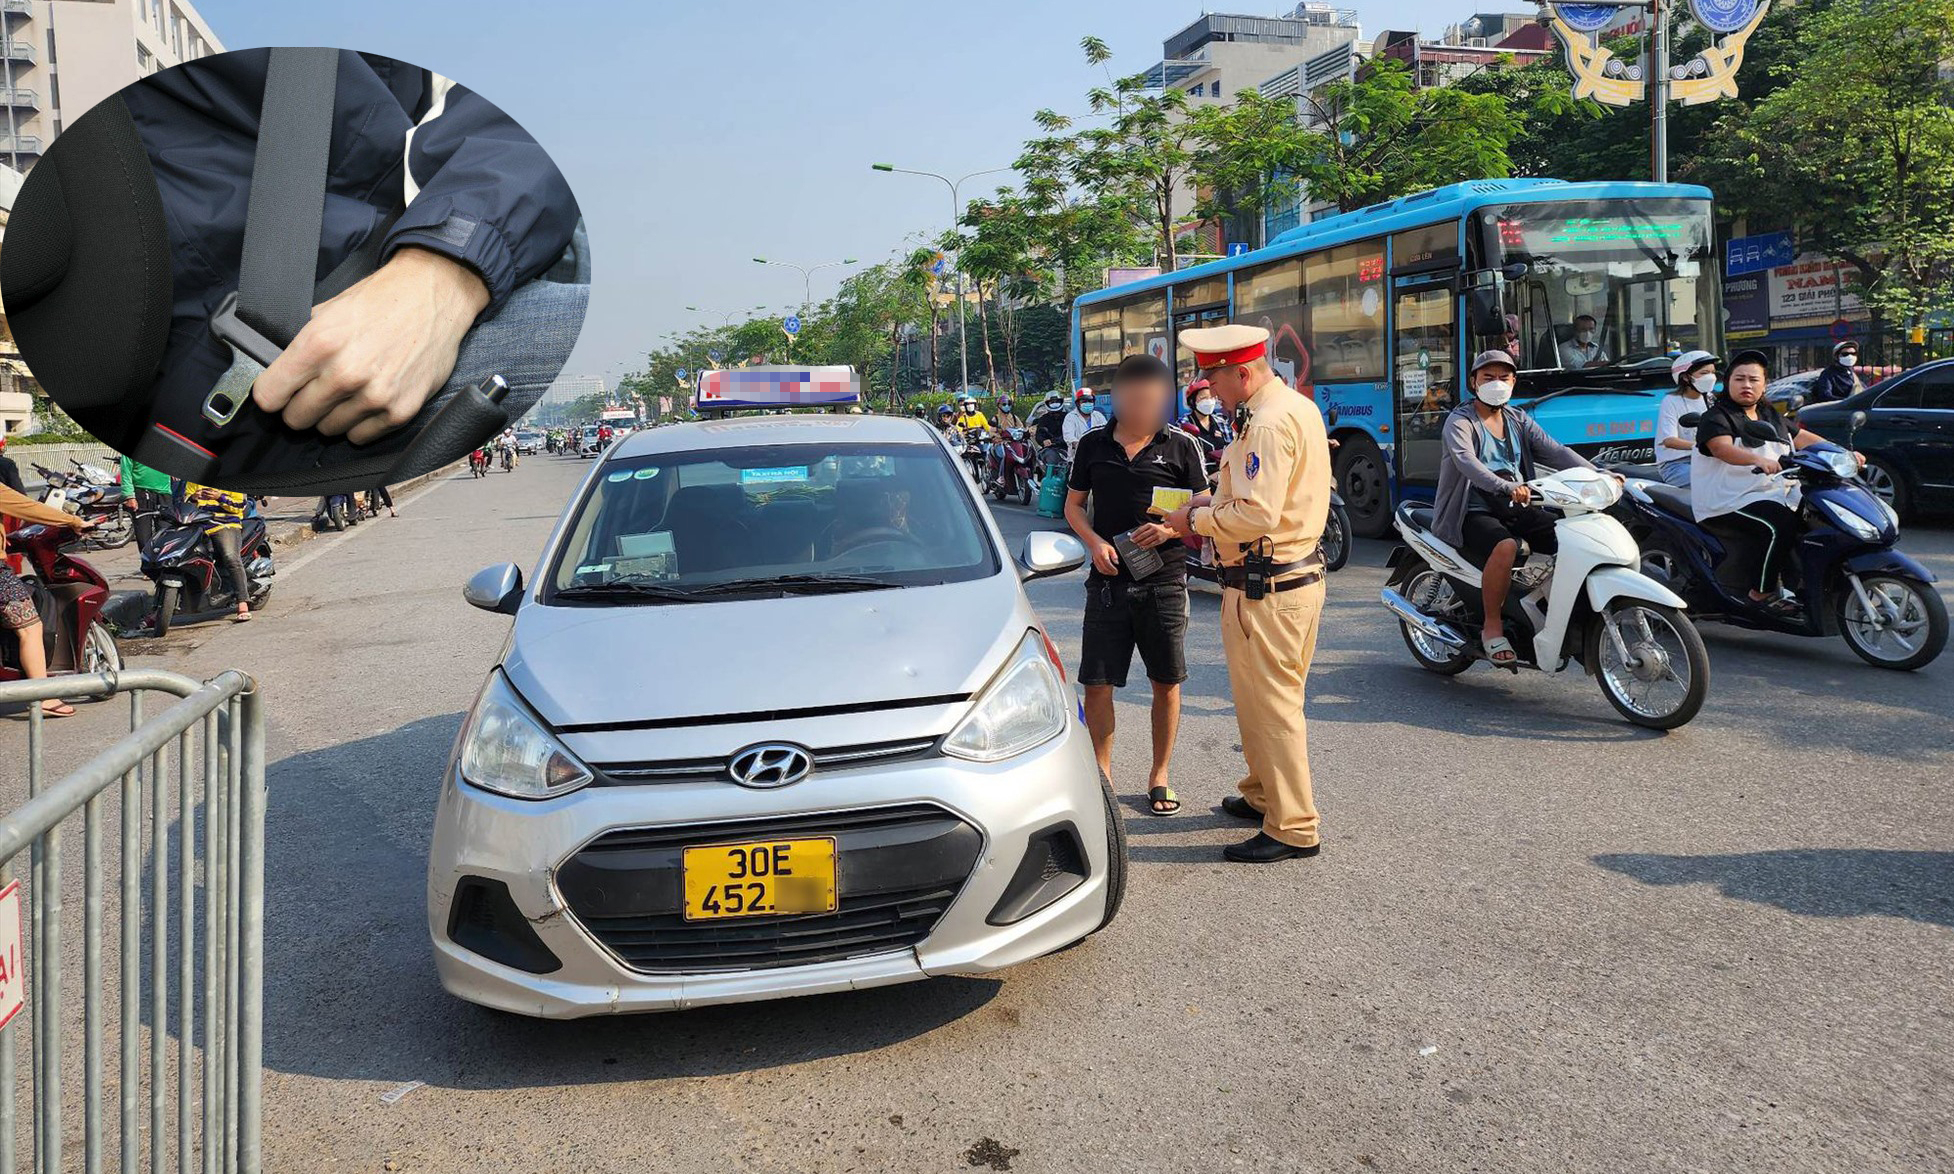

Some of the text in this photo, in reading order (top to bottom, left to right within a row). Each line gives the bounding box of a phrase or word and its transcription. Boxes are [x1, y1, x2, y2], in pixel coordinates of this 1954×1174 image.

[1786, 274, 1837, 290] NAM
[1781, 293, 1796, 303] 123
[1597, 446, 1653, 462] HANOIB
[728, 844, 792, 879] 30E
[701, 882, 776, 914] 452.
